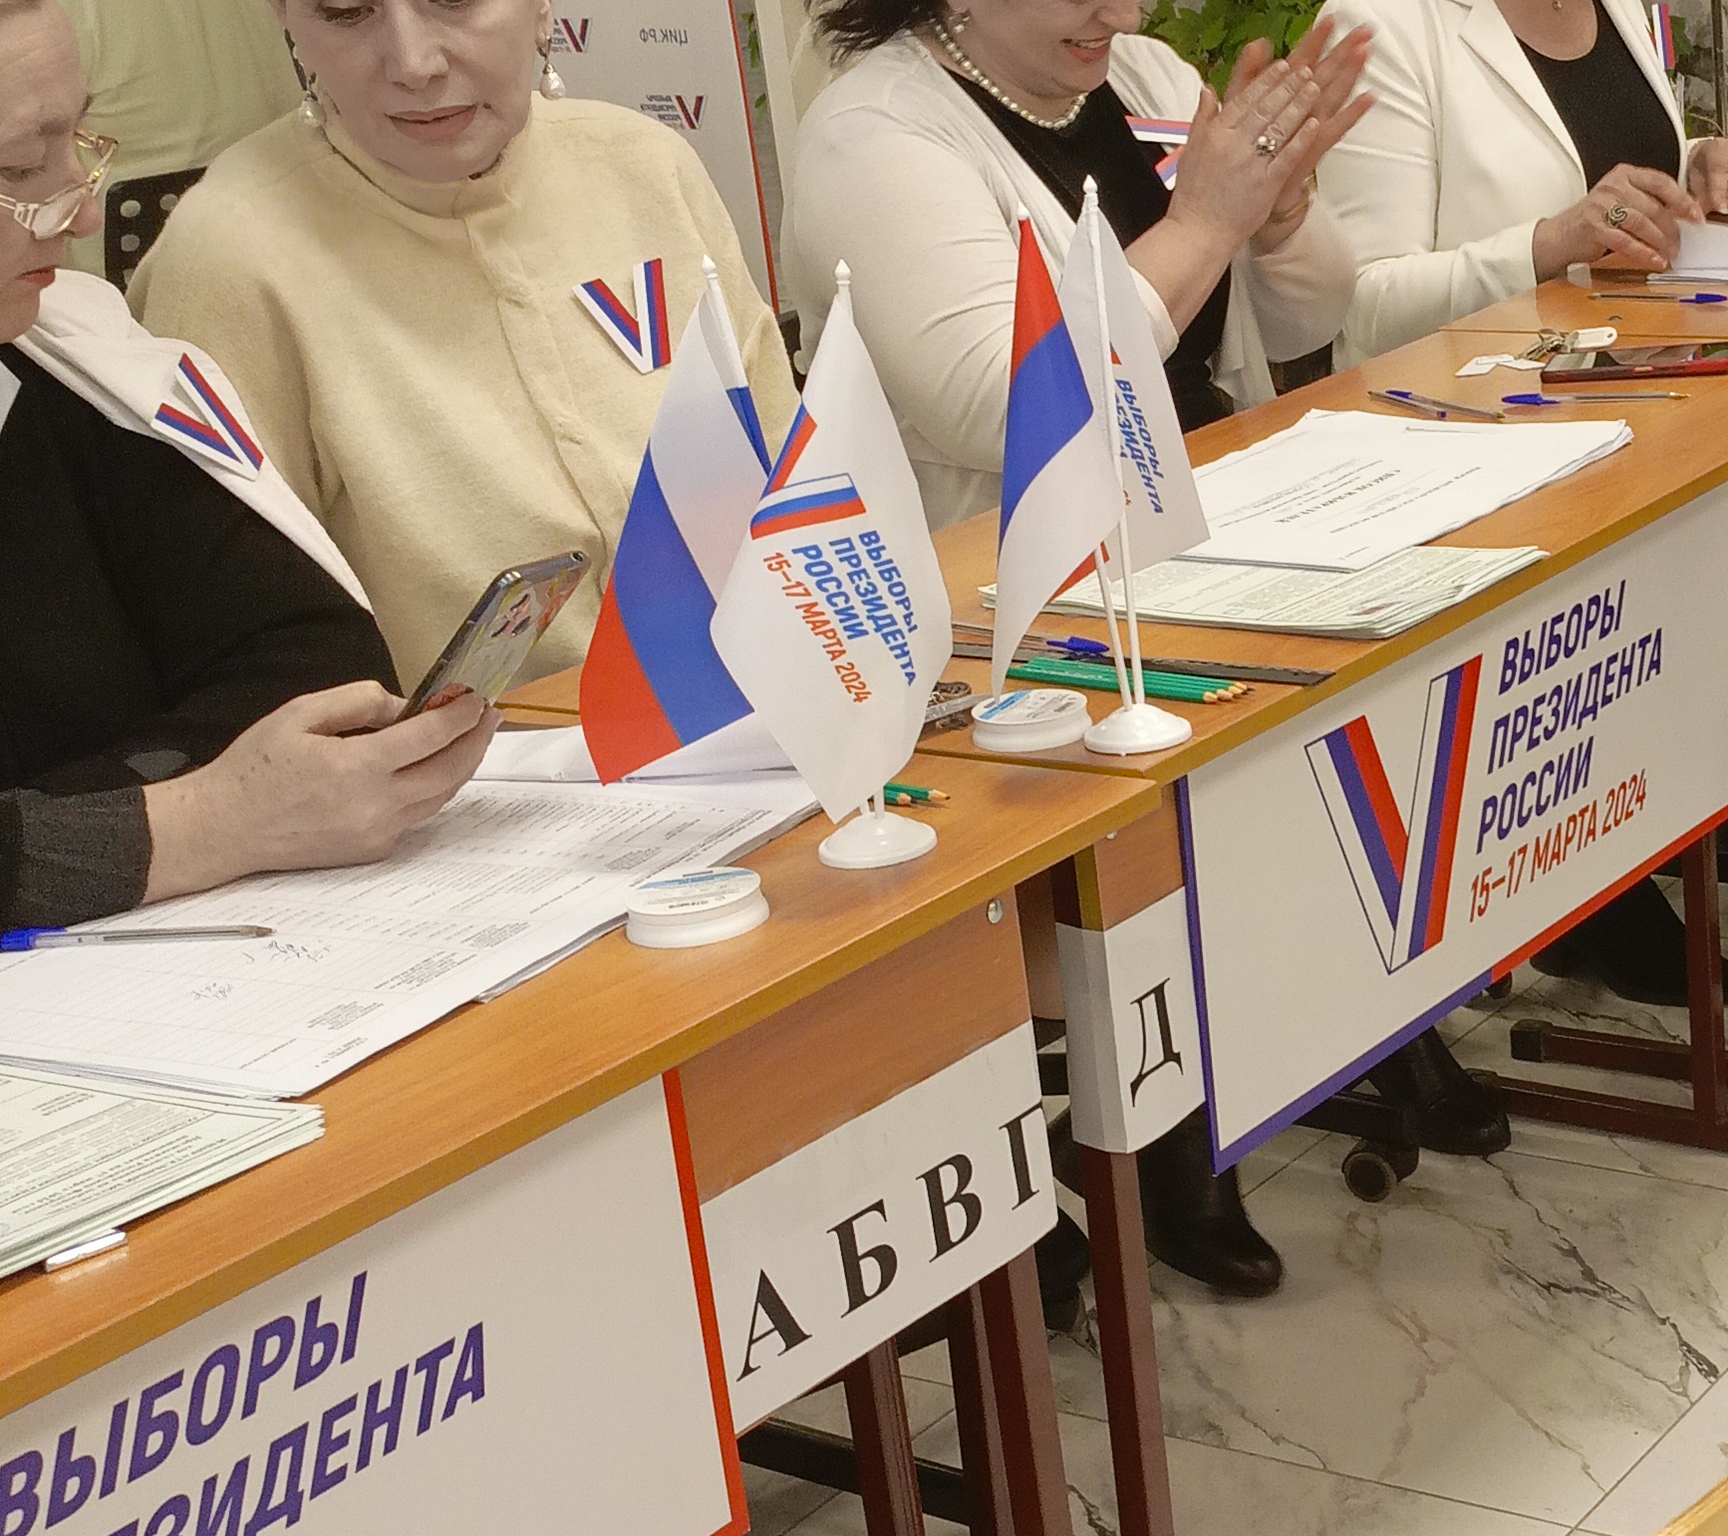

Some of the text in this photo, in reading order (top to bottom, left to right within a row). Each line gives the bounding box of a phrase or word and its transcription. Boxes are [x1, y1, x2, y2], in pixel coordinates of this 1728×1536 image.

[1114, 378, 1165, 479] ВЫБОРЫ
[791, 544, 870, 640] РОССИИ
[829, 537, 916, 687] ПРЕЗИДЕНТА
[858, 530, 918, 633] ВЫБОРЫ
[1498, 579, 1627, 696] ВЫБОРЫ
[795, 601, 847, 661] МАРТА
[834, 661, 872, 703] 2024
[1487, 626, 1663, 776] ПРЕЗИДЕНТА
[1475, 735, 1595, 856] РОССИИ
[1530, 799, 1598, 884] МАРТА
[1601, 768, 1647, 837] 2024
